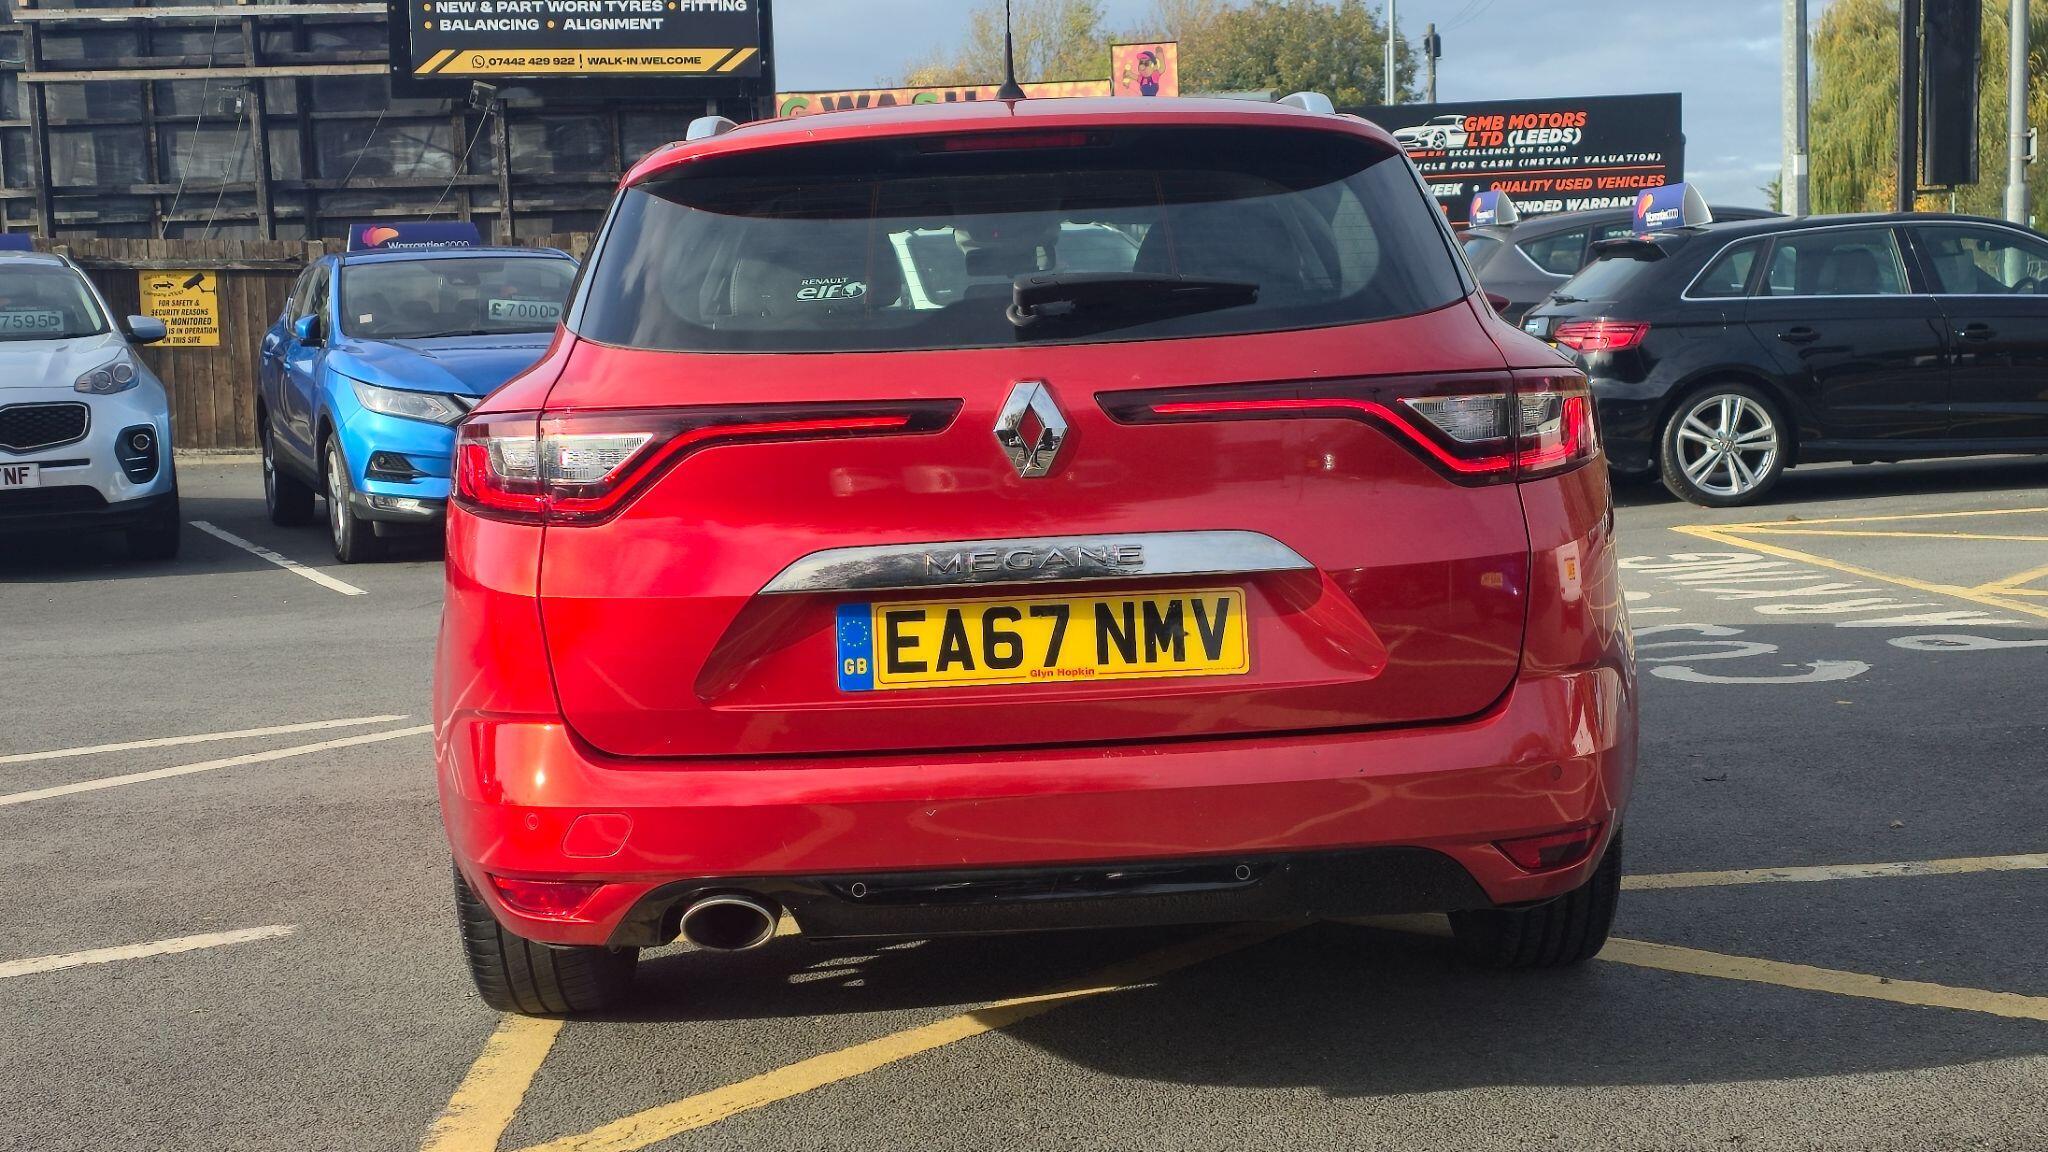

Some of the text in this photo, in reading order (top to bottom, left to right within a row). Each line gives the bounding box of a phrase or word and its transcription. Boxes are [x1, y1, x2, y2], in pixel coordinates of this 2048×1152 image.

[435, 0, 748, 13] NEW & PART WORN TYRES FITTING
[439, 18, 664, 31] BALANCING ALIGNMENT
[488, 56, 702, 66] 07442 429 922 WALK-IN WELCOME
[1463, 111, 1587, 131] GMB MOTORS
[1468, 128, 1582, 147] LTD (LEEDS)
[1448, 147, 1516, 157] EXCELLENCE
[1538, 145, 1567, 153] ROAD
[1415, 153, 1662, 171] ICLE FOR CASH (INSTANT VALUATION)
[1490, 179, 1554, 193] QUALITY
[1555, 178, 1593, 191] USED
[1597, 174, 1666, 189] VEHICLES
[1511, 200, 1563, 214] ENDED
[1566, 195, 1639, 211] WARRANT
[801, 277, 848, 285] RENAULT
[796, 284, 842, 299] elf
[158, 299, 170, 307] FOR
[171, 299, 194, 307] SAFETY
[151, 308, 209, 316] SECURITY REASONS
[170, 317, 212, 326] MONITORED
[168, 326, 218, 335] IS IN OPERATION
[172, 336, 186, 344] THIS
[187, 336, 201, 344] SITE
[0, 466, 30, 485] NF
[925, 544, 1144, 576] MEGANE
[884, 597, 1231, 675] EA67 NMV
[843, 657, 868, 675] GB
[1030, 667, 1095, 678] Glyn Hopkin
